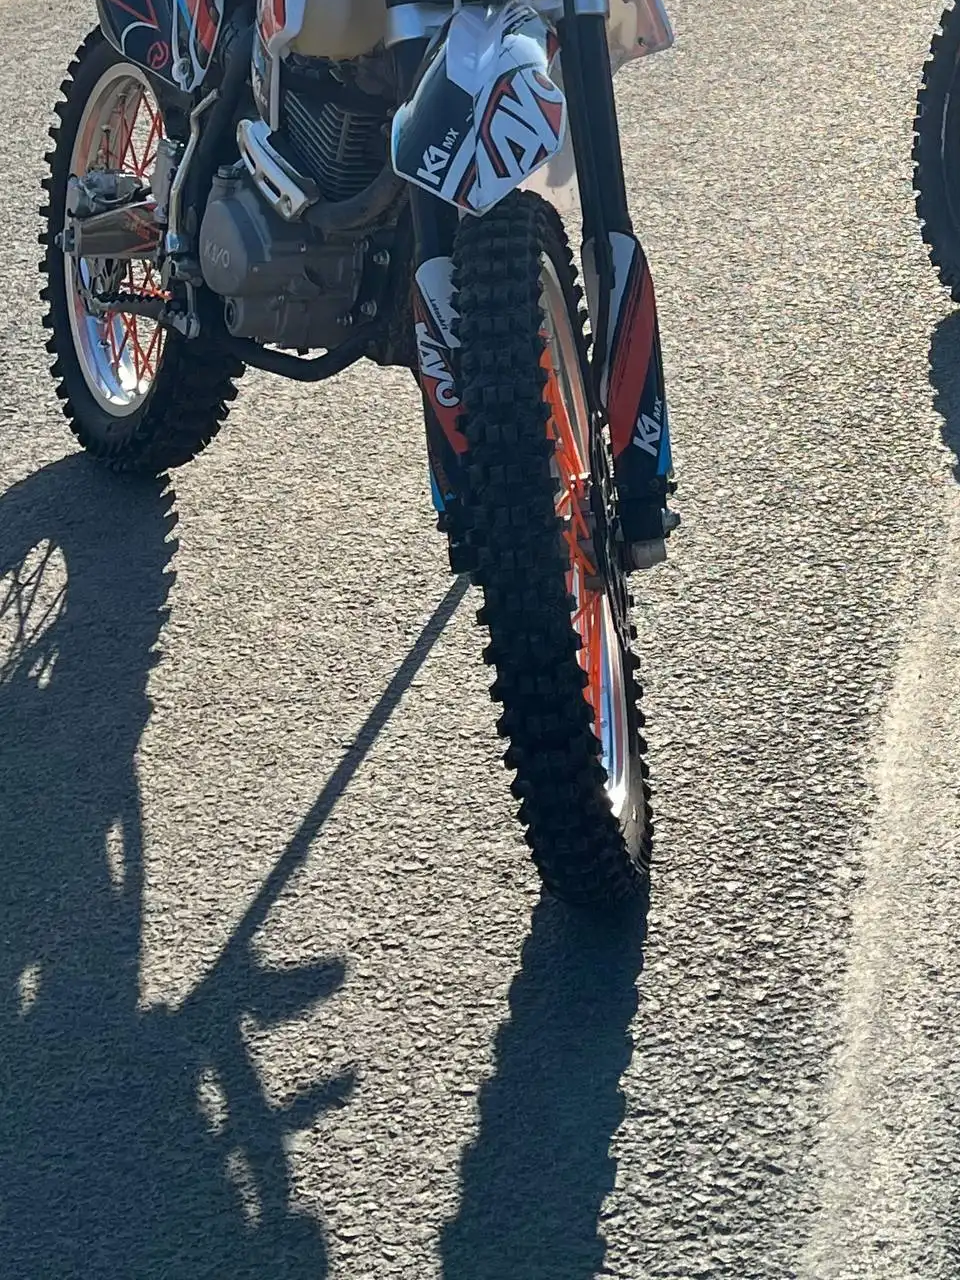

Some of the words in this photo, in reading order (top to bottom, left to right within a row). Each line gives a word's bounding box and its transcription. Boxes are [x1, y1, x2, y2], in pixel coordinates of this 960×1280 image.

[416, 144, 449, 186] K1
[442, 127, 460, 149] MX
[633, 413, 662, 456] K1
[652, 399, 663, 419] MX
